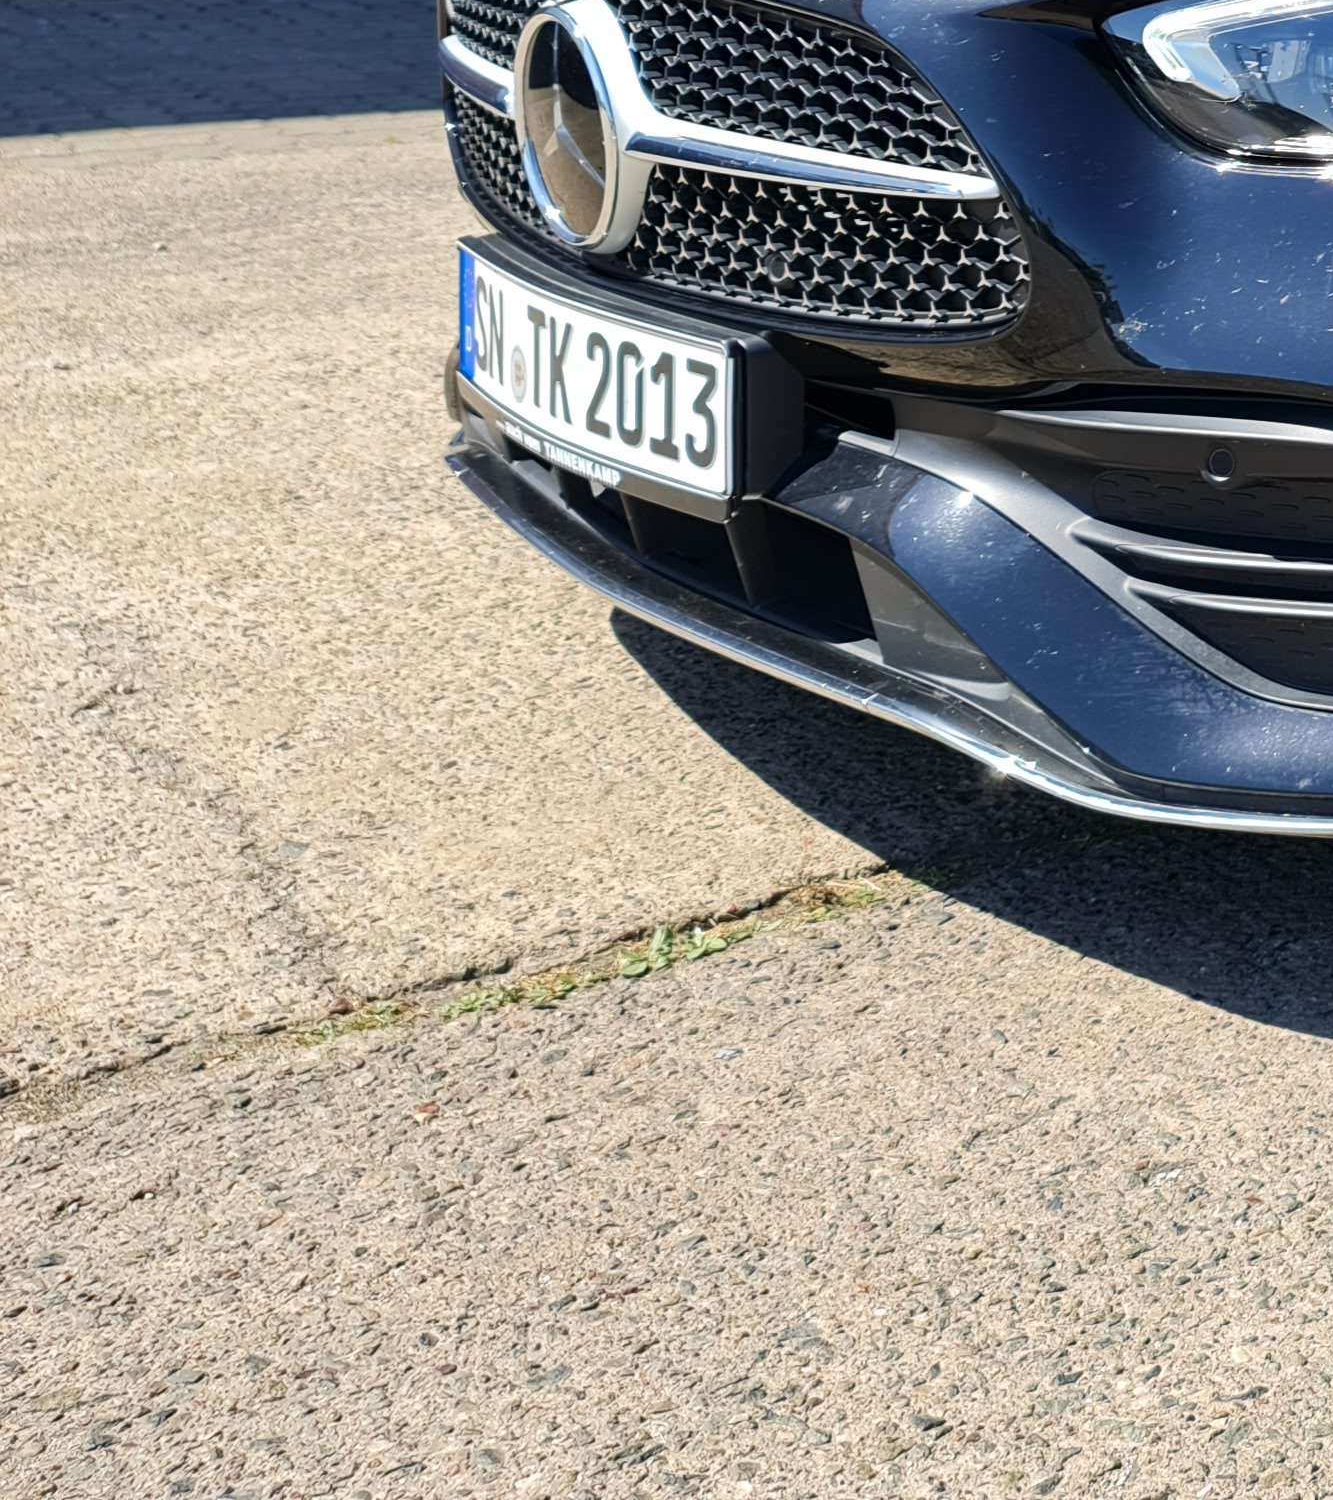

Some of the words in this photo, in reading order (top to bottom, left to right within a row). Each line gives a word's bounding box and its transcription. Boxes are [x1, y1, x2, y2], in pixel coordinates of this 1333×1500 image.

[477, 275, 503, 386] SN
[527, 304, 572, 425] TK
[586, 331, 719, 470] 2013
